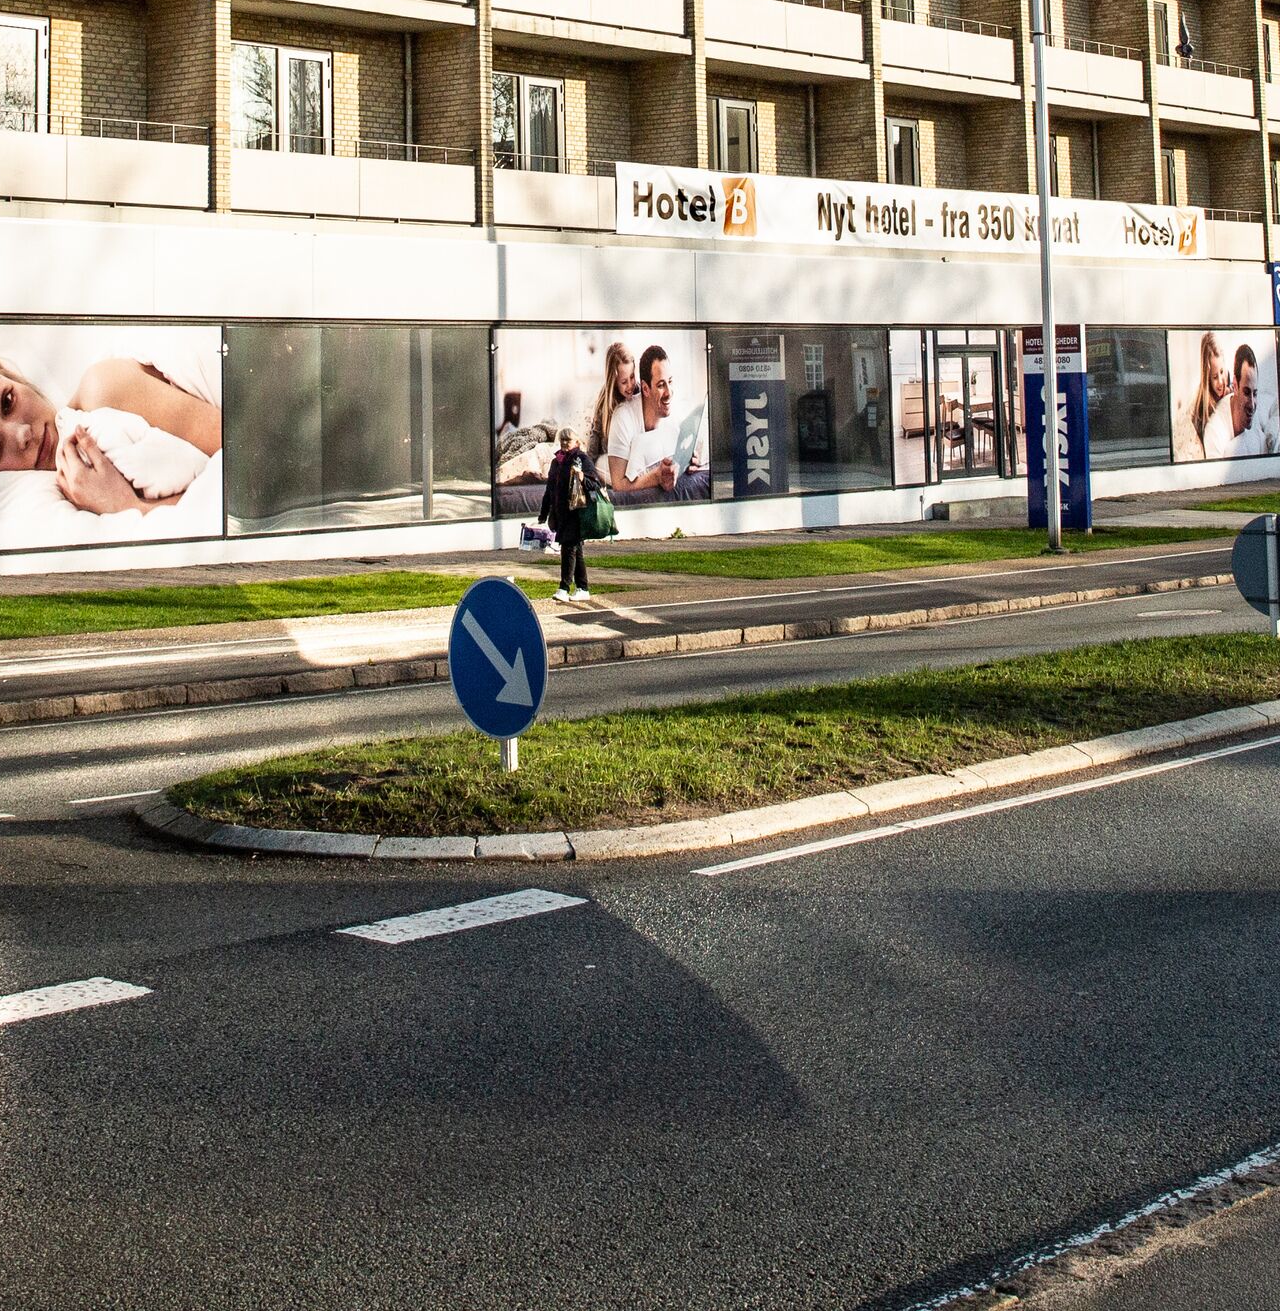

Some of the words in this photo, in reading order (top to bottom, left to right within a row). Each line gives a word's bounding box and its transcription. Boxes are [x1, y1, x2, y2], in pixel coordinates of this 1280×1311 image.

[633, 180, 716, 223] Hotel
[731, 188, 748, 225] B
[817, 192, 856, 241] Nyt
[865, 195, 916, 236] hotel
[924, 218, 934, 227] -
[941, 201, 970, 238] fra
[978, 204, 1015, 241] 350
[1122, 216, 1175, 246] Hotel
